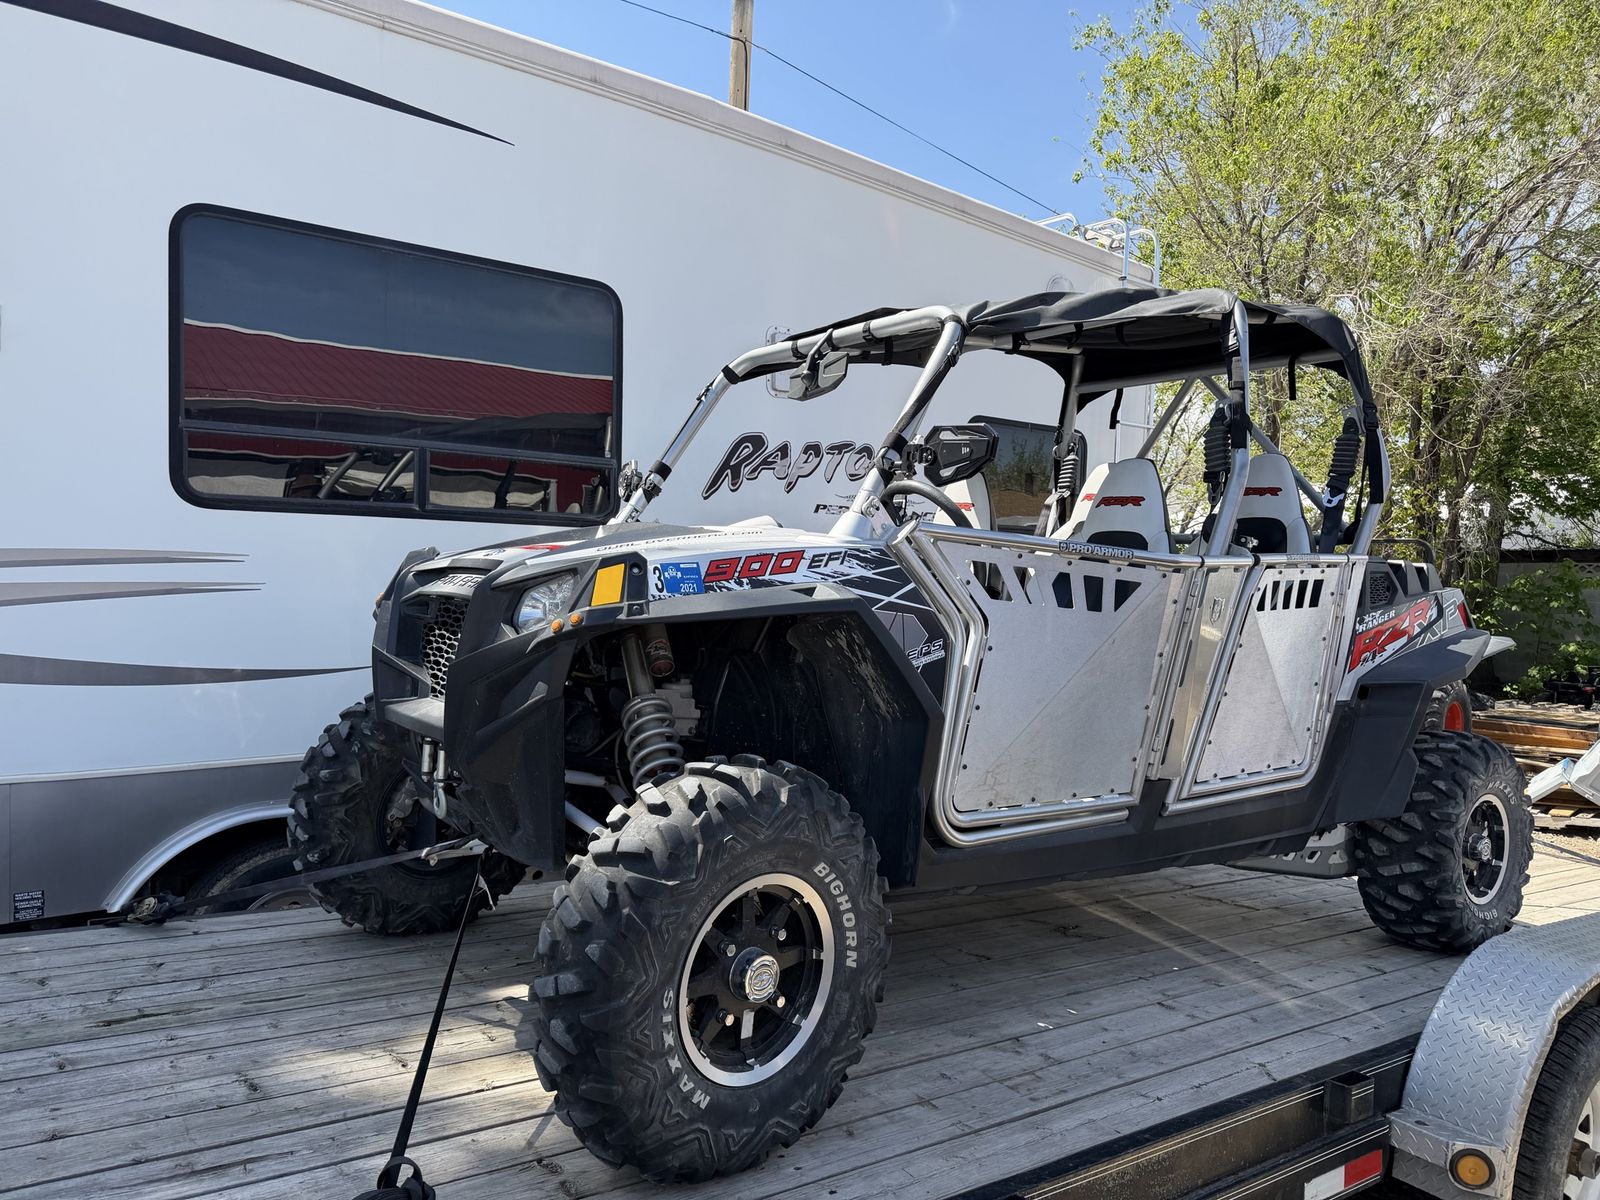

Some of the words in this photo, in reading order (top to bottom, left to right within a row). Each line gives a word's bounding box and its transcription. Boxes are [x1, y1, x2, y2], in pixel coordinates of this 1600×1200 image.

[702, 431, 876, 500] RAPTO
[1069, 543, 1092, 554] PRO
[1094, 547, 1134, 559] ARMOR
[653, 565, 665, 593] 3
[702, 549, 805, 583] 900
[807, 550, 848, 569] EFI
[680, 583, 698, 593] 2021
[1347, 596, 1432, 674] RZR
[1359, 609, 1396, 633] RANGER
[906, 638, 943, 659] EPS
[1486, 781, 1517, 805] MAXXIS
[813, 862, 858, 968] BIGHORN
[662, 988, 711, 1110] MAXXIS
